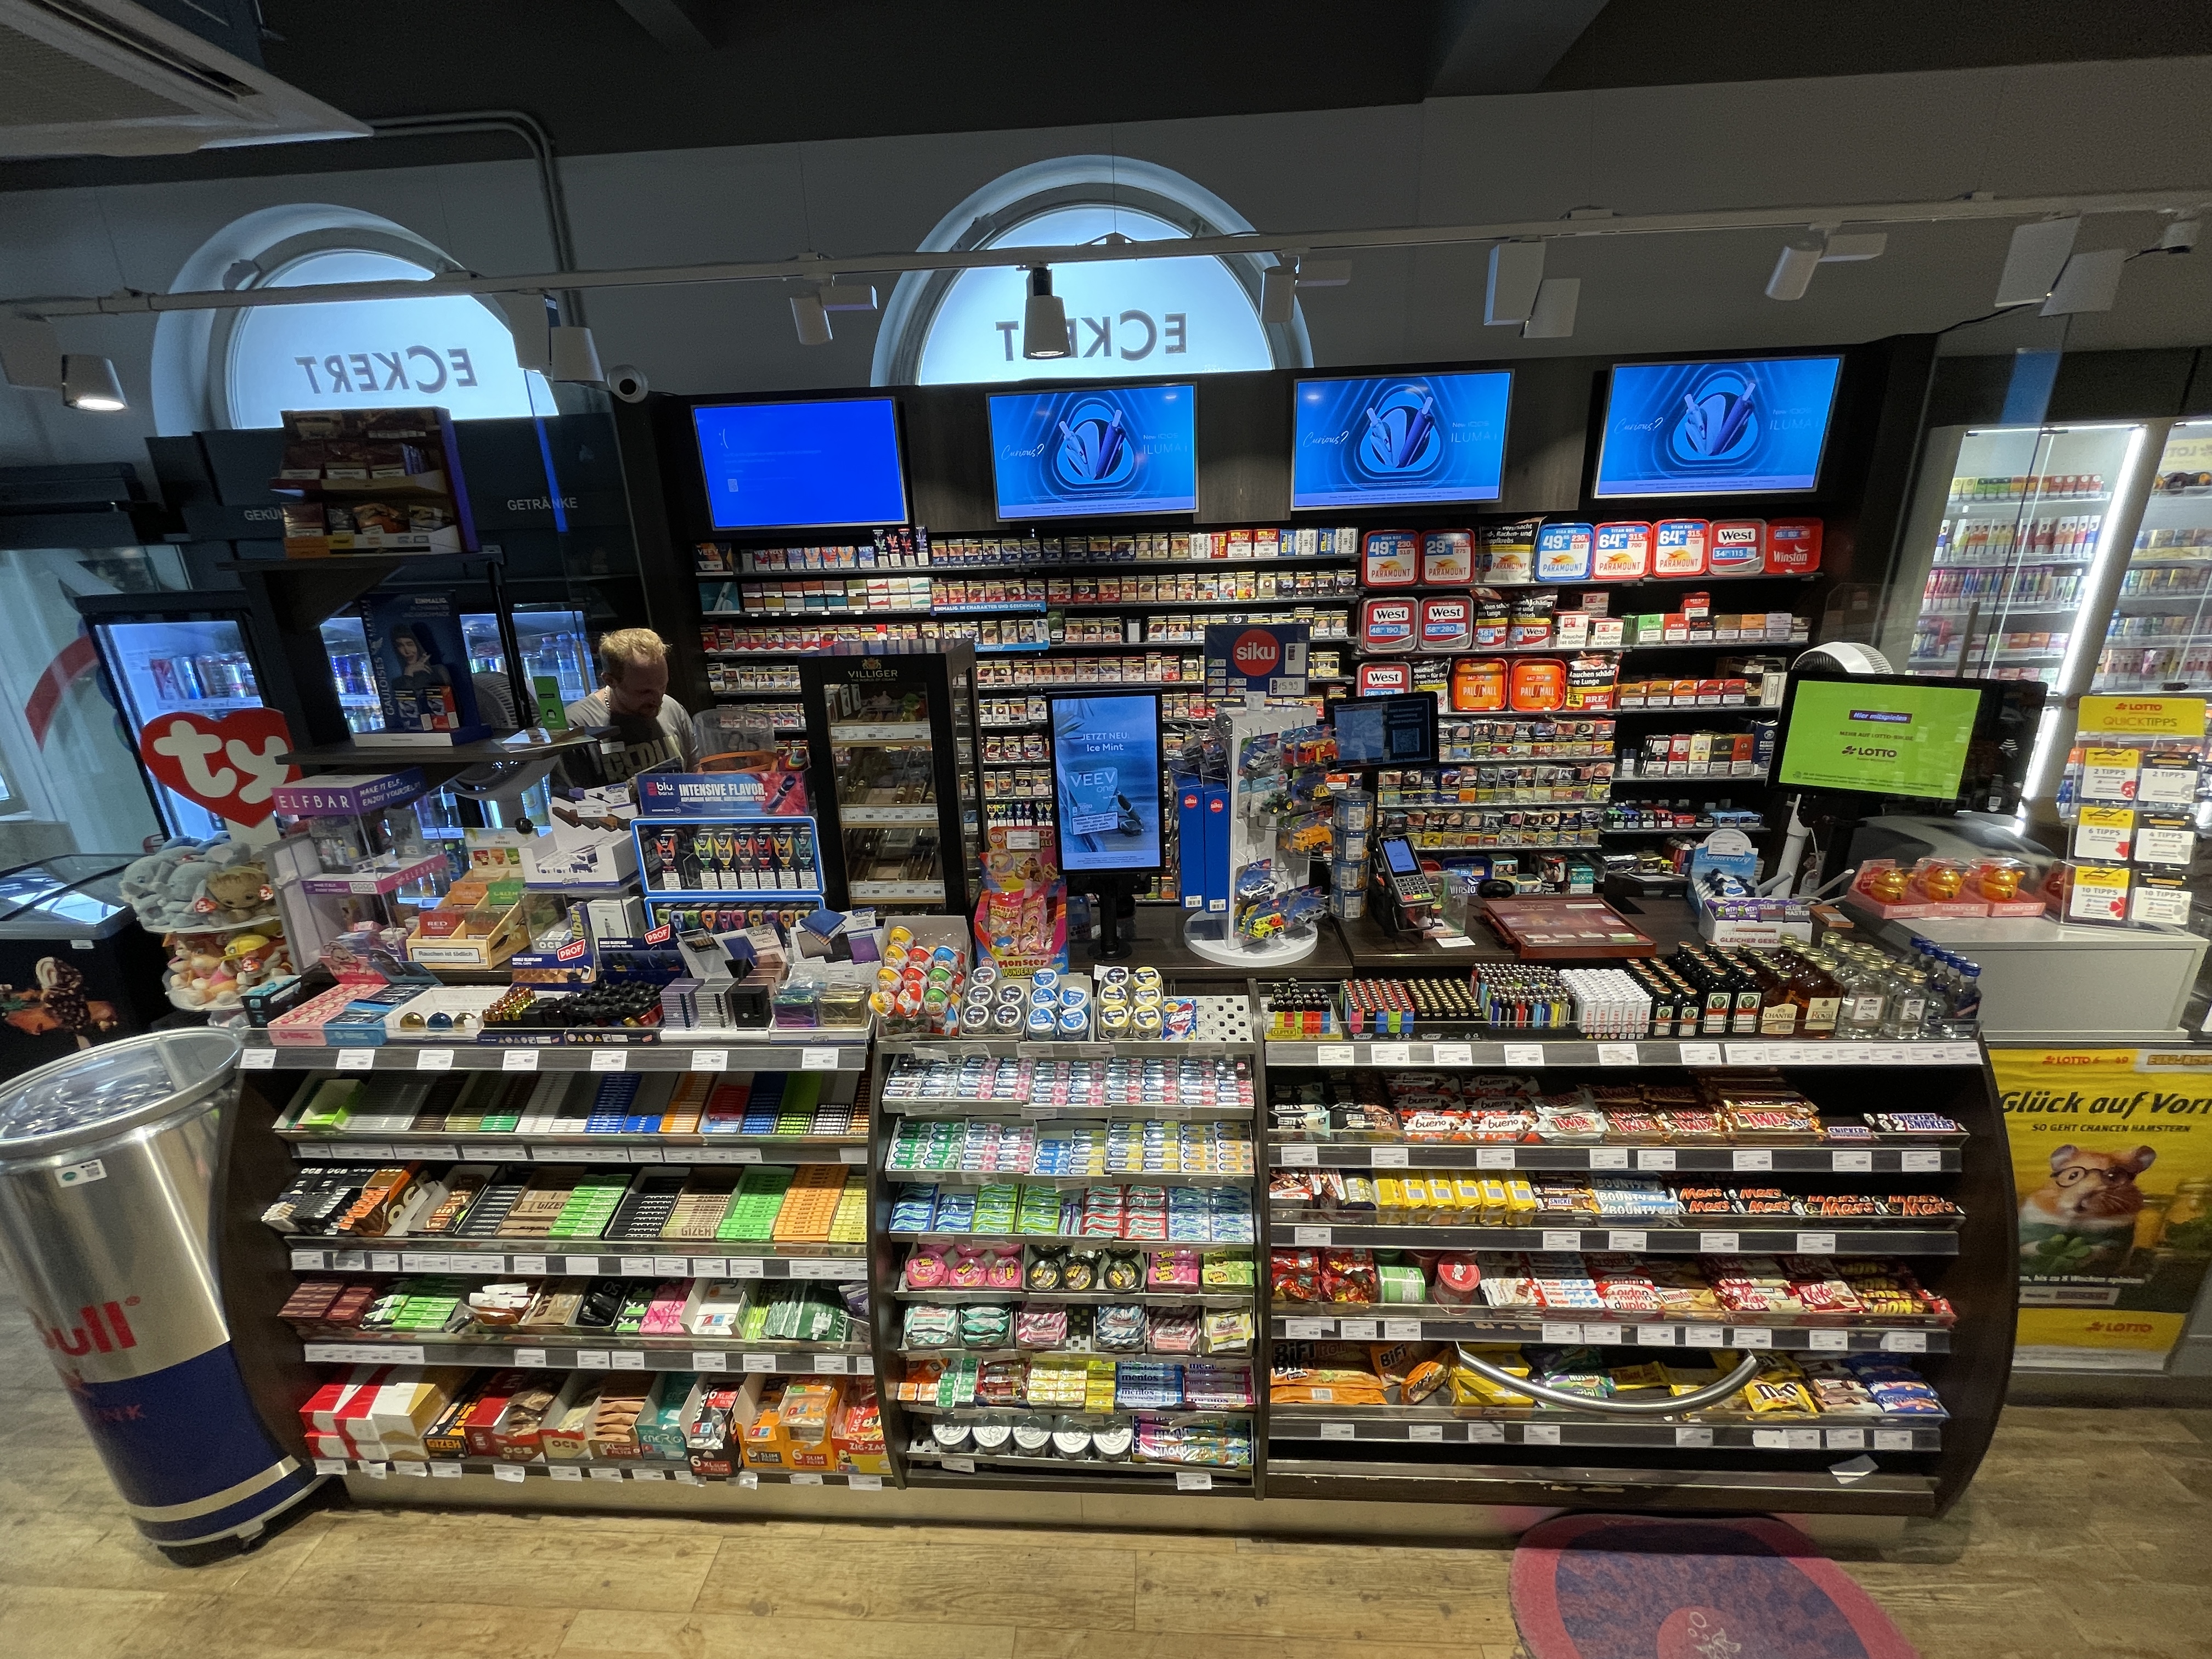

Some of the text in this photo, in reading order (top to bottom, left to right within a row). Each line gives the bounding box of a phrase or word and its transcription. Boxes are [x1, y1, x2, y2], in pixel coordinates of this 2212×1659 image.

[1613, 416, 1663, 434] Curious?
[1303, 431, 1349, 448] Curious?
[1001, 443, 1045, 460] Curious?
[507, 496, 578, 511] GETRÄNKE
[1722, 531, 1752, 540] West
[1773, 551, 1807, 562] Winston
[1543, 563, 1582, 572] PARAMOUNT
[1599, 562, 1641, 571] PARAMOUNT
[1660, 558, 1699, 567] PARAMOUNT
[1372, 569, 1410, 577] PARAMOUNT
[1429, 567, 1466, 576] PARAMOUNT
[1376, 610, 1406, 619] West
[1432, 607, 1460, 617] West
[1526, 627, 1545, 635] West
[1236, 642, 1276, 660] siku
[848, 670, 898, 679] VILLIGER
[1370, 673, 1399, 681] West
[382, 657, 394, 715] GAULOISES
[1463, 686, 1497, 696] PALL MALL
[1521, 687, 1554, 696] PALL MALL
[2103, 716, 2177, 727] QUICKTIPPS
[1081, 733, 1108, 741] JETZT
[1086, 742, 1124, 752] Ice Mint
[1858, 747, 1898, 758] LOTTO
[153, 720, 290, 805] ty
[1070, 771, 1116, 788] VEEV
[678, 784, 727, 796] INTENSIVE
[1096, 784, 1115, 793] one
[279, 795, 350, 809] ELFBAR
[647, 929, 669, 943] PROF
[539, 941, 562, 950] OCB
[559, 943, 584, 959] PROF
[998, 958, 1047, 968] Monster
[1408, 1096, 1438, 1104] bueno
[1481, 1100, 1511, 1108] bueno
[2003, 1091, 2085, 1114] Glück
[2089, 1091, 2150, 1120] auf
[1415, 1116, 1446, 1128] bueno
[1488, 1118, 1519, 1129] bueno
[1895, 1120, 1955, 1131] 2 SNICKERS
[1600, 1192, 1646, 1201] BOUNTY
[1680, 1188, 1722, 1200] Mars
[1740, 1189, 1782, 1199] Mars
[1610, 1206, 1656, 1215] BOUNTY
[1689, 1200, 1730, 1214] Mars
[1748, 1200, 1790, 1214] Mars
[1821, 1202, 1874, 1216] Mars
[1903, 1201, 1955, 1216] Mars
[1661, 1291, 1691, 1302] hanuta
[1614, 1300, 1647, 1310] duplo
[1380, 1344, 1408, 1367] BiFi
[1116, 1373, 1159, 1382] mentos
[708, 1390, 716, 1400] 6
[427, 1439, 461, 1450] GIZEH
[552, 1440, 579, 1449] OCB
[503, 1446, 534, 1455] OCB
[746, 1446, 757, 1458] 6
[792, 1449, 803, 1460] 6
[690, 1455, 701, 1466] 6
